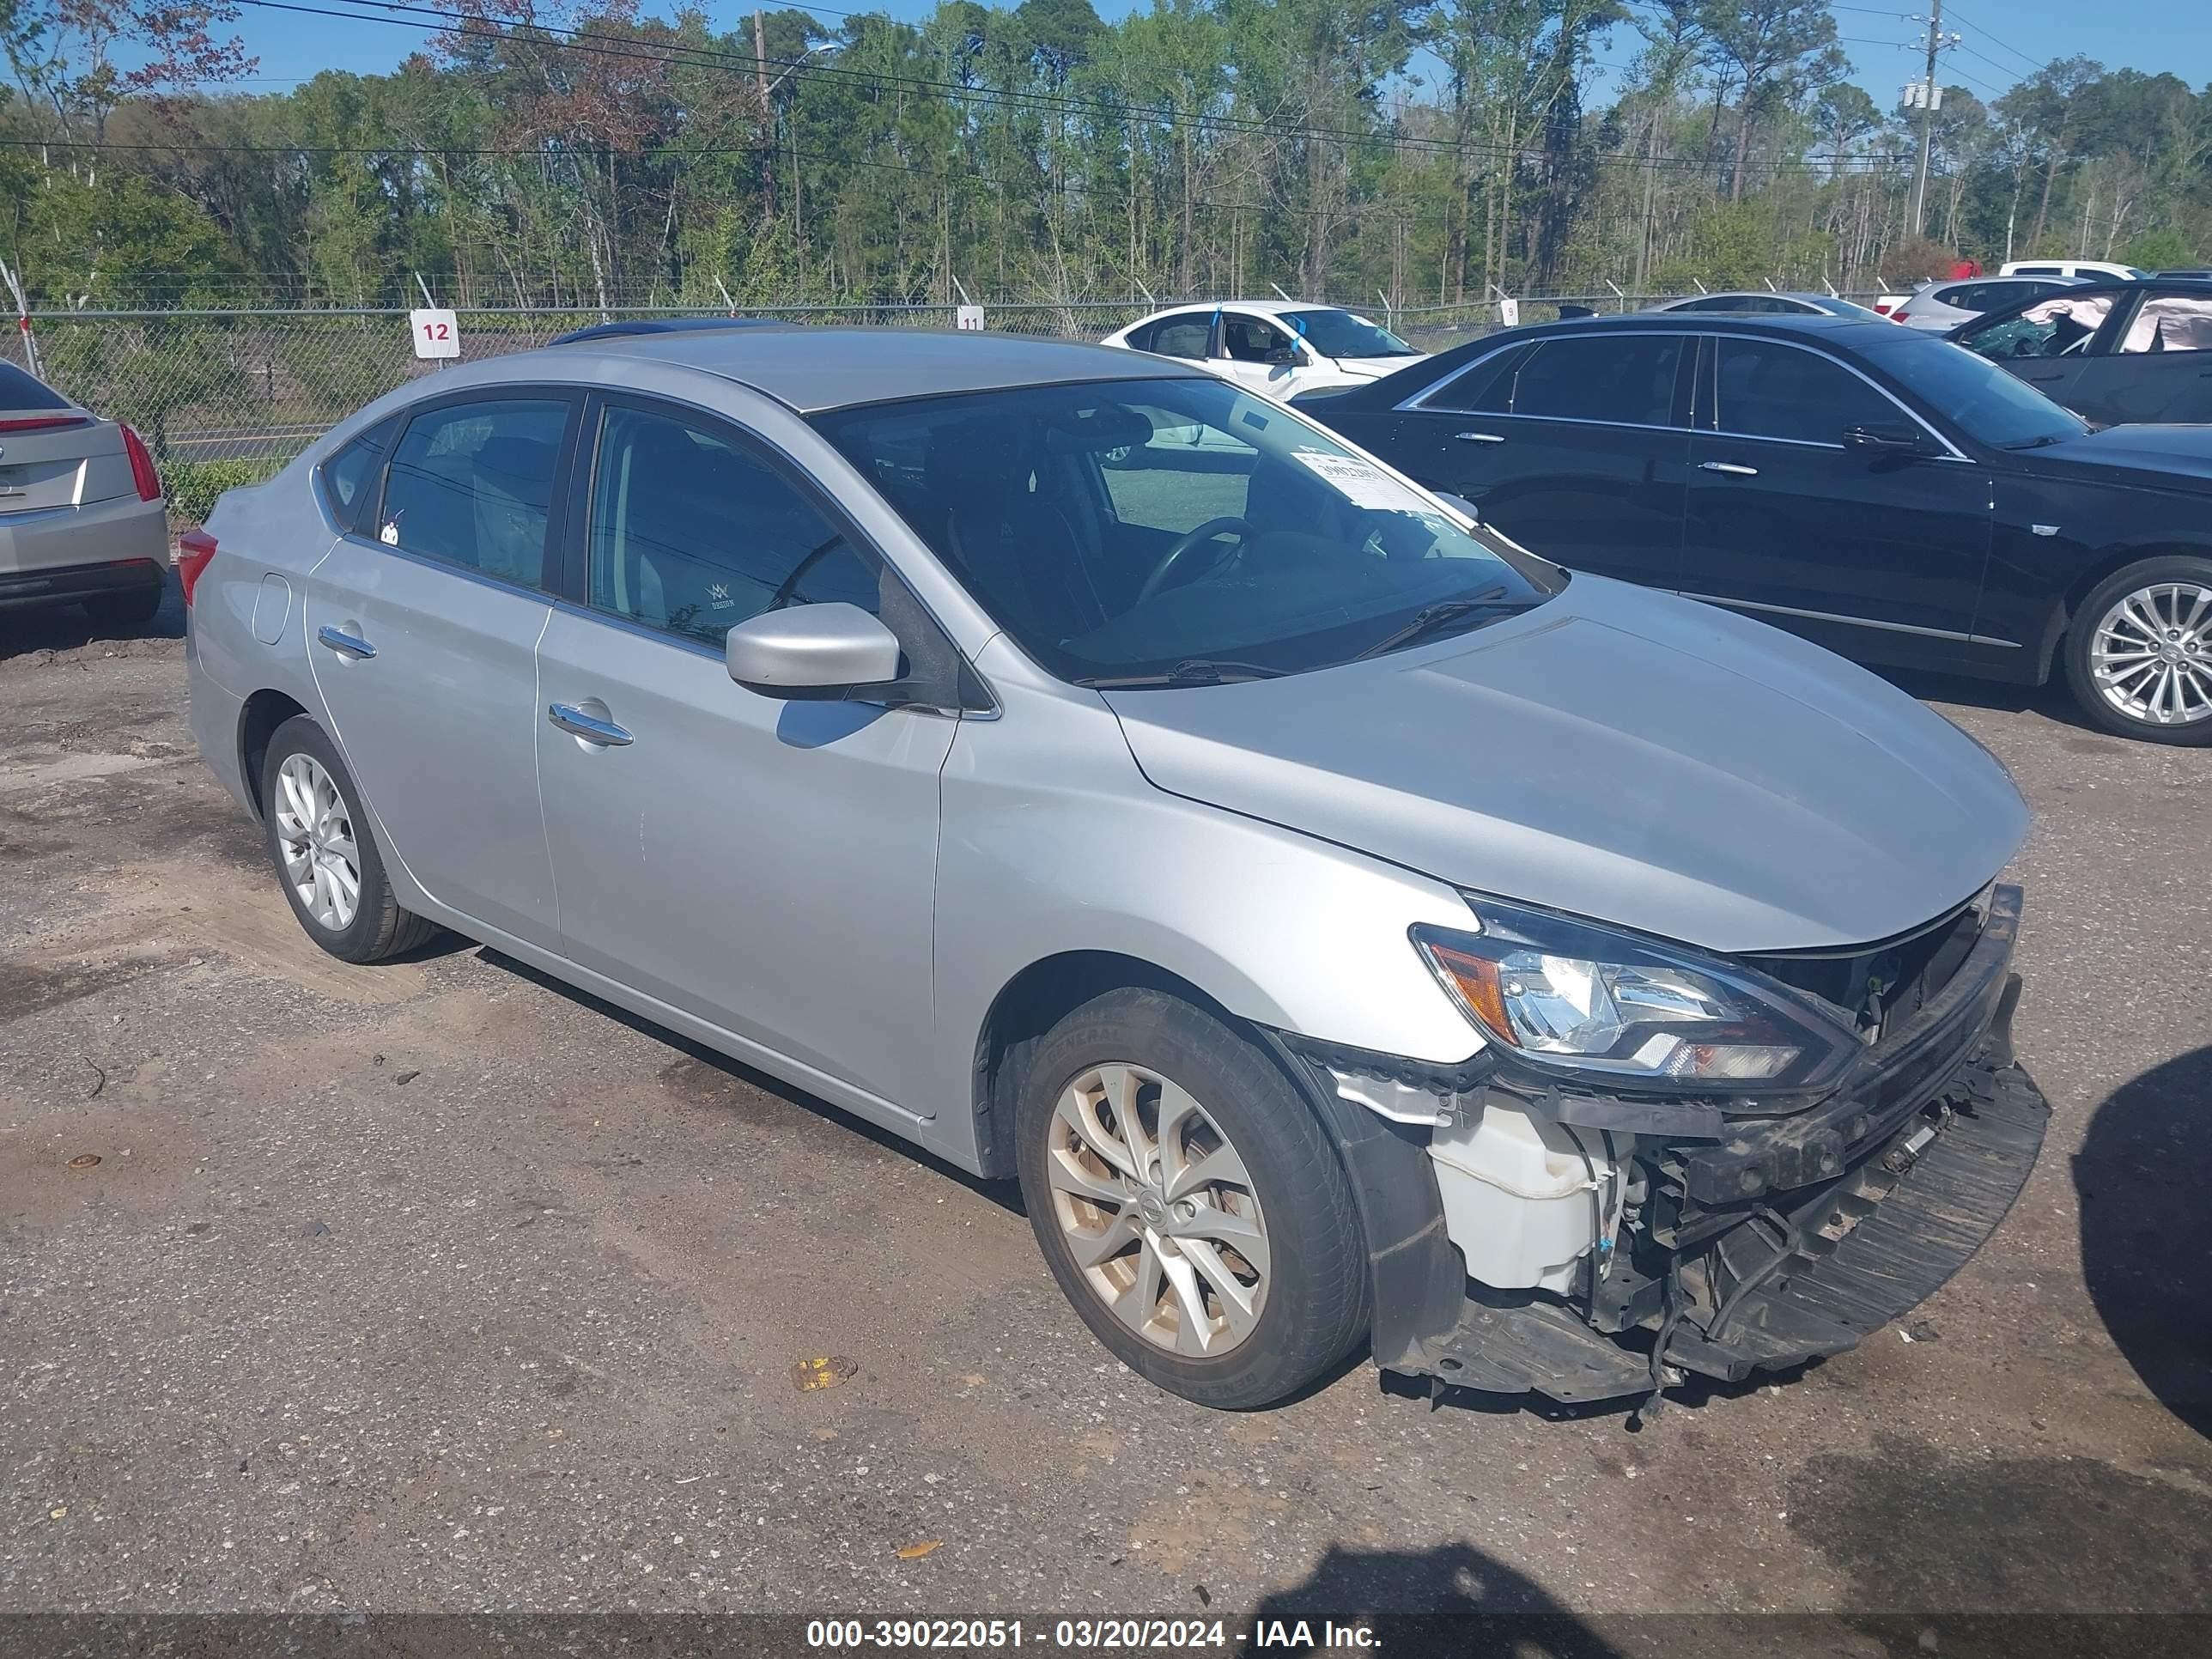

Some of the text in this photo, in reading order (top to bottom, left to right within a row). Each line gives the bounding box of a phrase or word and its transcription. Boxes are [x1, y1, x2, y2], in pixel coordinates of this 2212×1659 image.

[1508, 307, 1514, 316] 9
[963, 318, 977, 330] 11
[423, 324, 449, 340] 12
[712, 599, 735, 610] DESIGN
